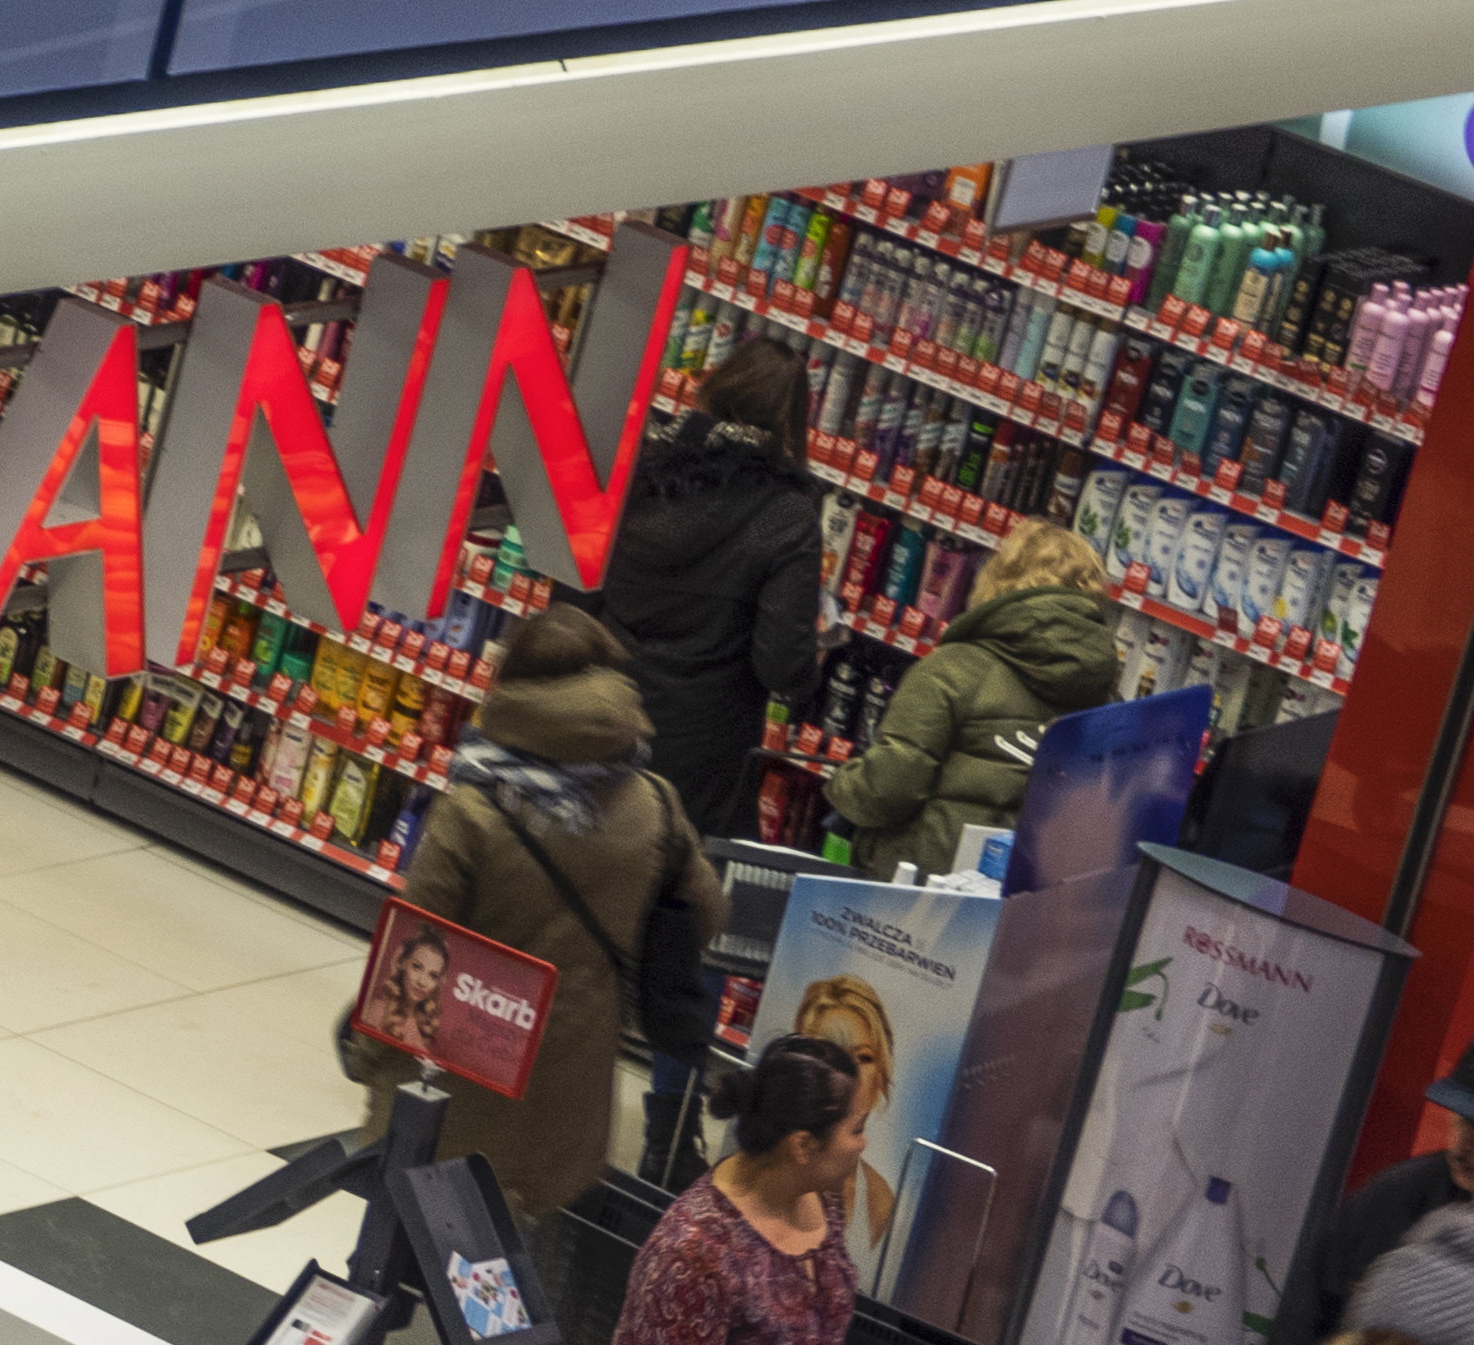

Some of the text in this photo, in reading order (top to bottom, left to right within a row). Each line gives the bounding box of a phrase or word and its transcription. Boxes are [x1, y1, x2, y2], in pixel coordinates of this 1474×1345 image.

[811, 910, 848, 936] 100%
[841, 906, 912, 947] ZWALCZA
[1183, 925, 1314, 993] ROSSMANN
[453, 972, 536, 1031] Skarb
[1196, 982, 1260, 1025] Dove
[1158, 1264, 1222, 1302] Dove
